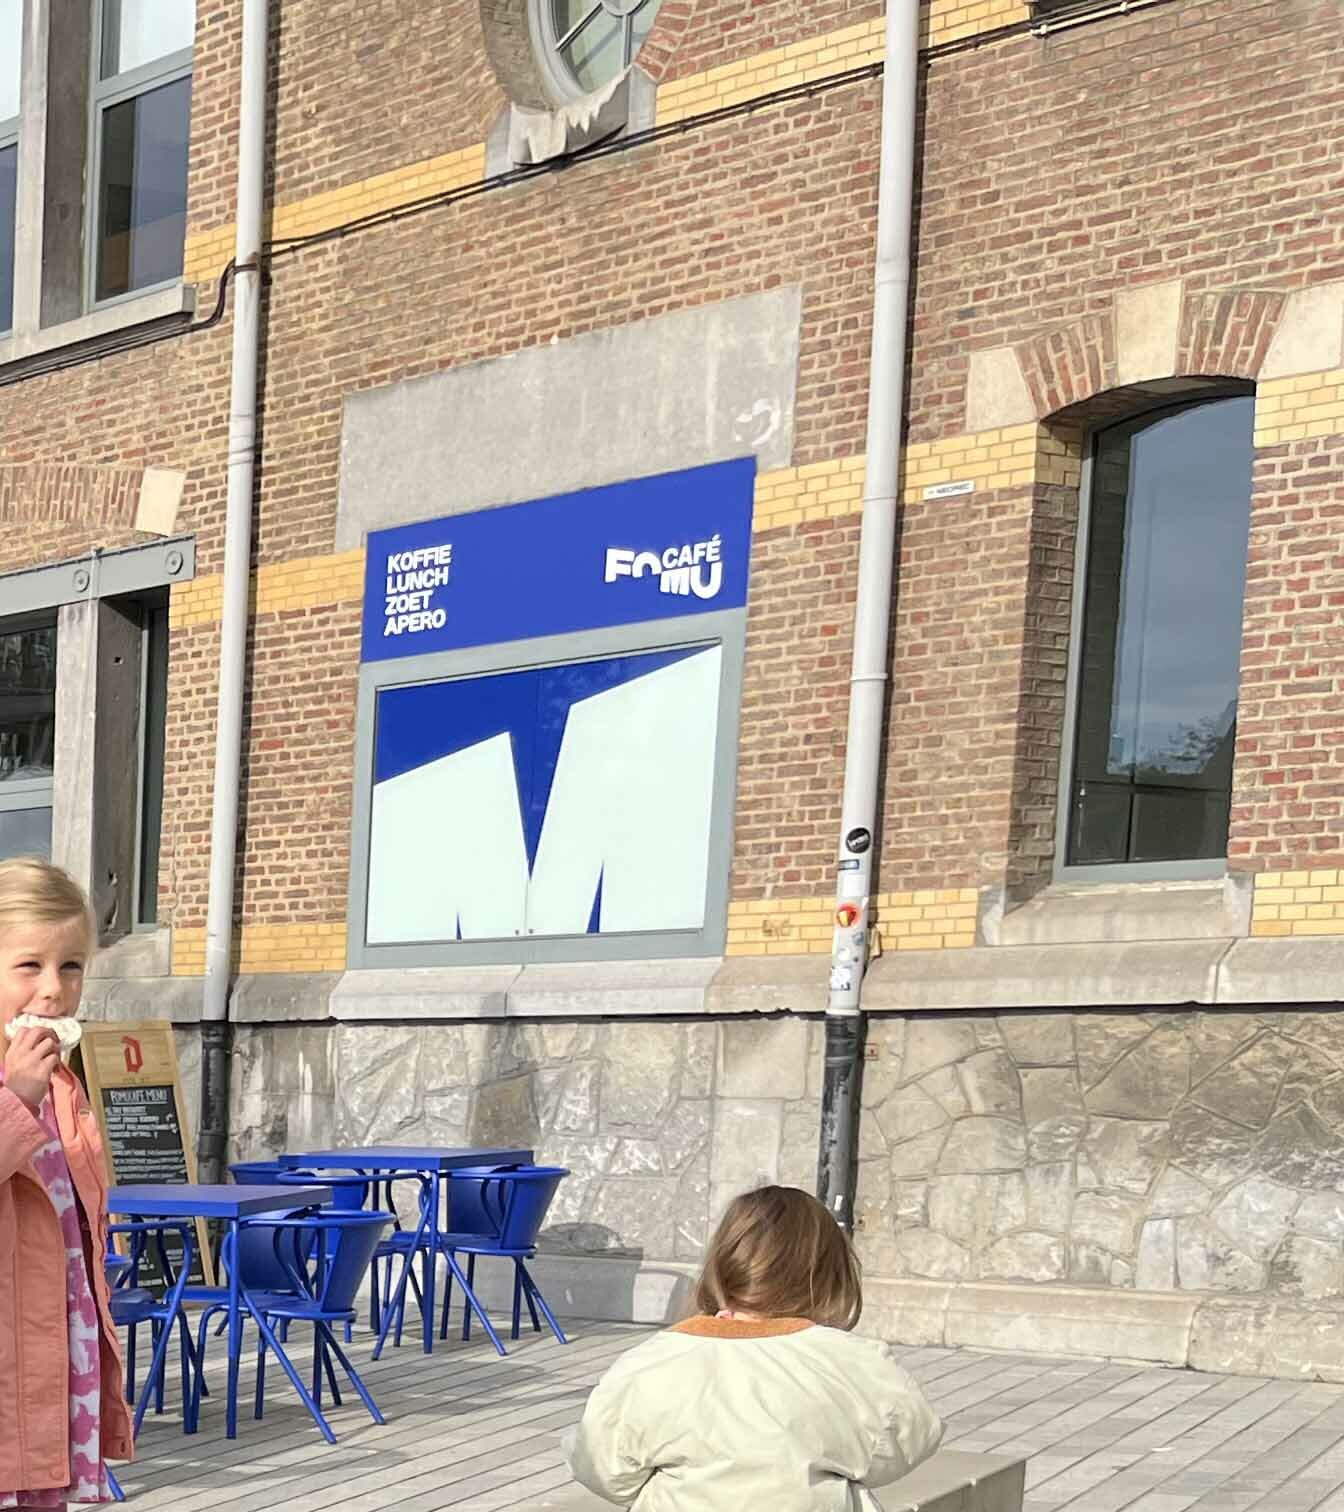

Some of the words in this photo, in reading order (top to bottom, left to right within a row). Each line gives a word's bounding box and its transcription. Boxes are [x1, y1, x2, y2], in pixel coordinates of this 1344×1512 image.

[387, 544, 452, 574] KOFFIE
[662, 534, 722, 568] CAFÉ
[386, 566, 449, 595] LUNCH
[384, 590, 433, 616] ZOET
[384, 608, 446, 637] APERO
